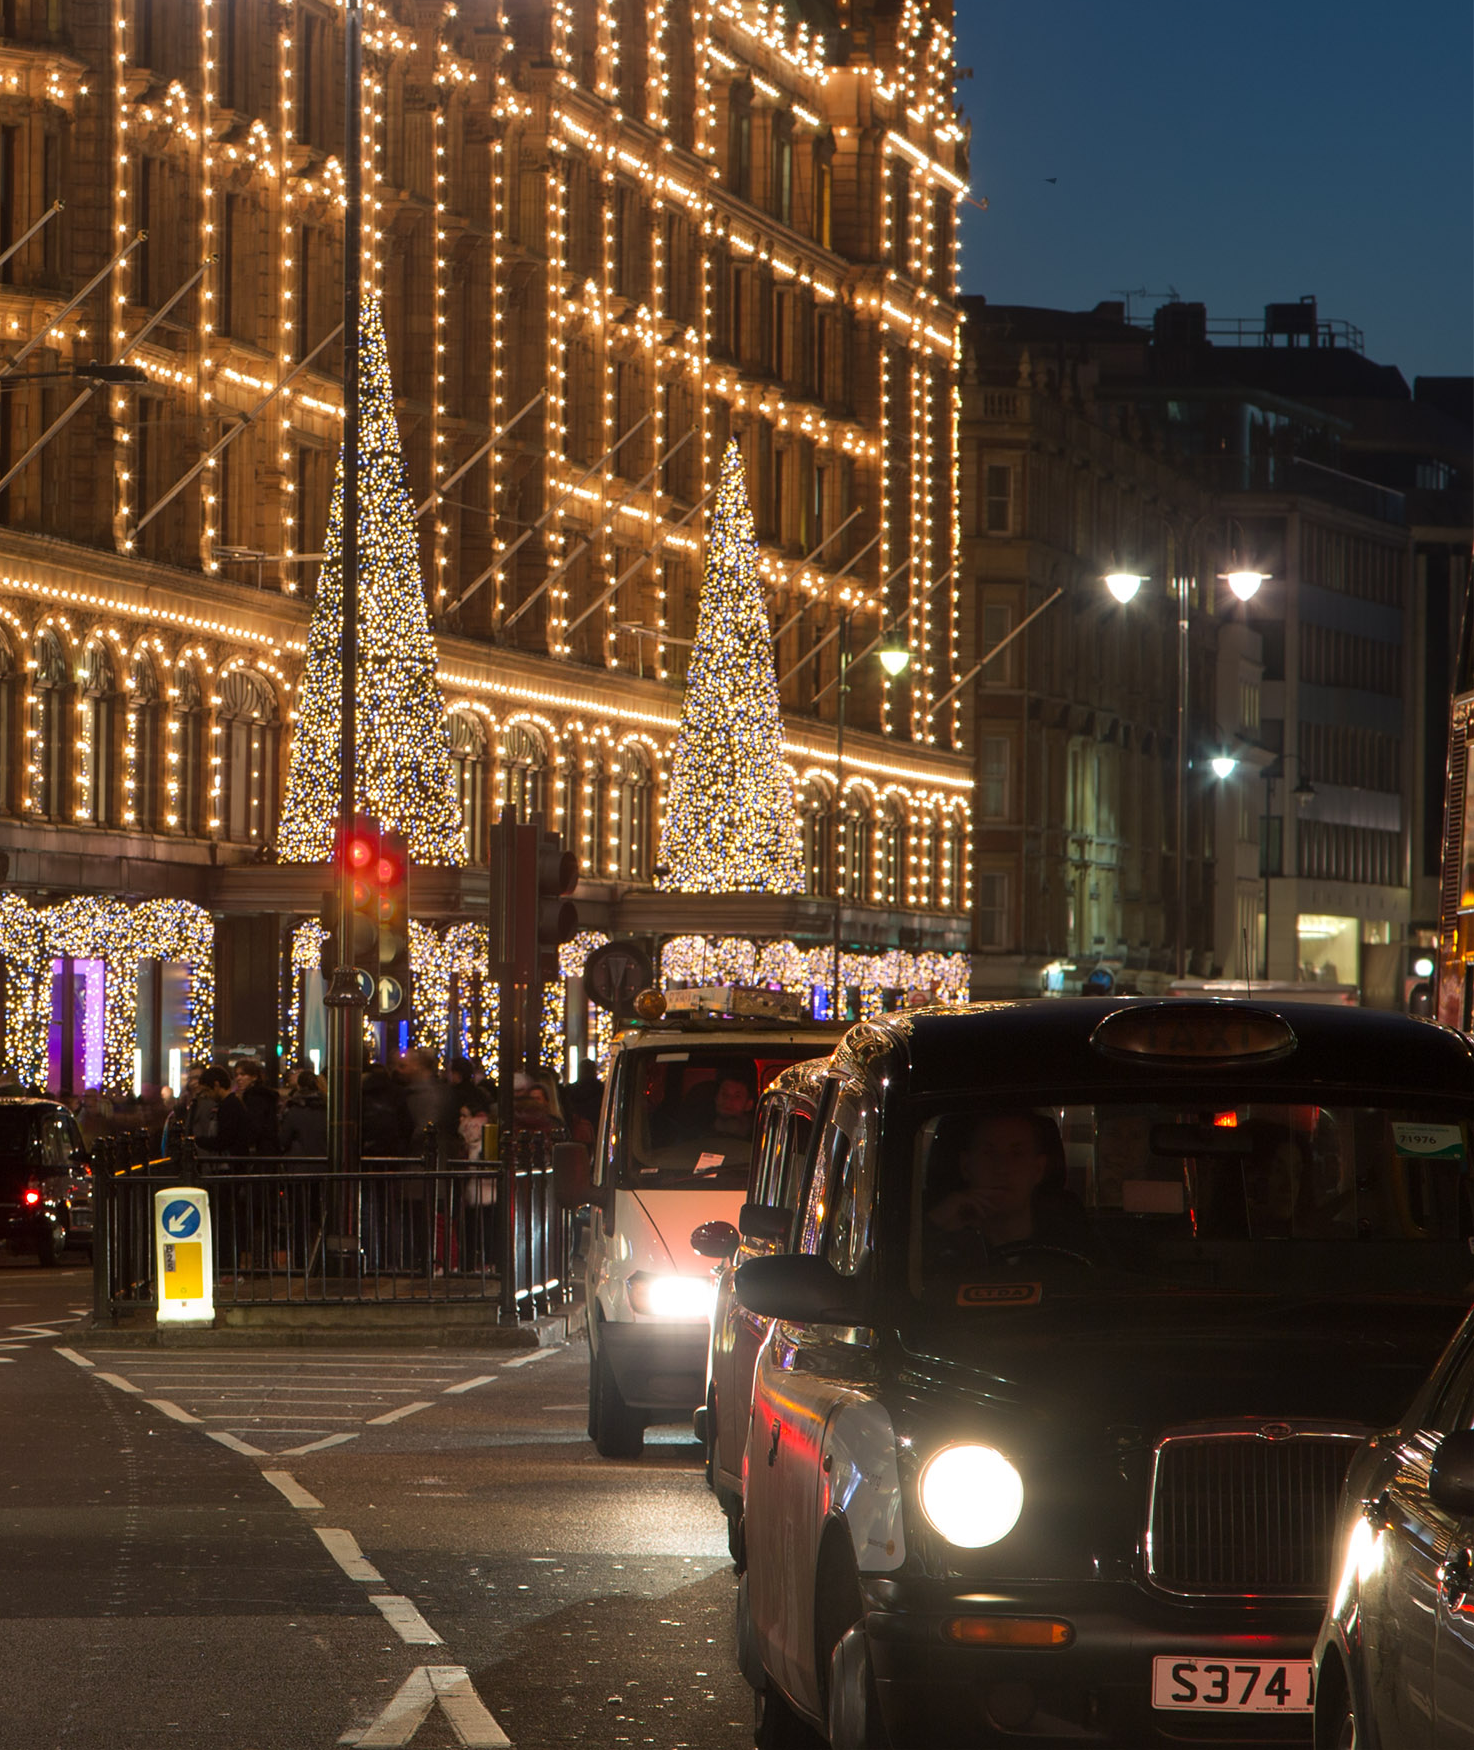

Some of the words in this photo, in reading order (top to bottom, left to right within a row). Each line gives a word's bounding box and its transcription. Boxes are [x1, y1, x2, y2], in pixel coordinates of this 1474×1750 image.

[1142, 1020, 1252, 1049] TAXI
[1399, 1134, 1437, 1145] 71976
[1171, 1663, 1292, 1706] S374
